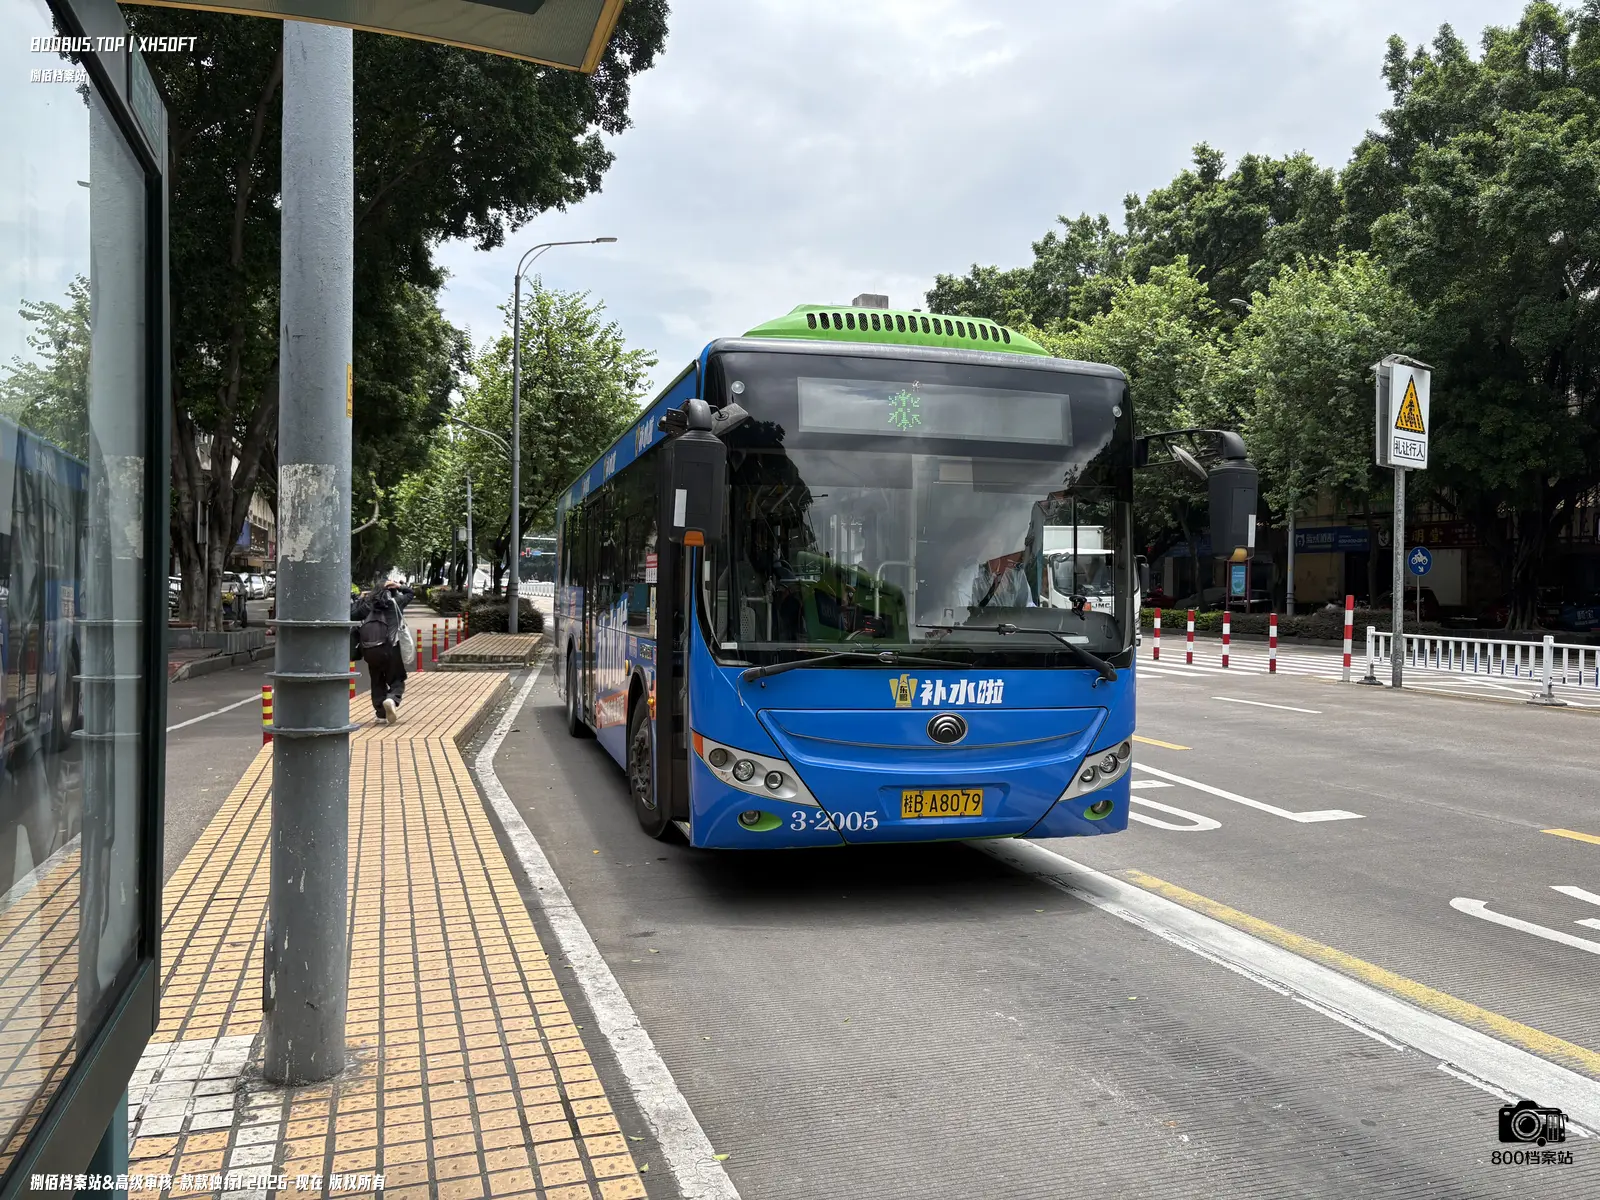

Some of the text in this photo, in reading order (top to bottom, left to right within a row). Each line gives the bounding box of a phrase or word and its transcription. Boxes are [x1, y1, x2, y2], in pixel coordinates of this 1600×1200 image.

[1394, 440, 1424, 458] 礼让行人
[920, 678, 1005, 706] 补水啦
[790, 810, 879, 831] 3-2005
